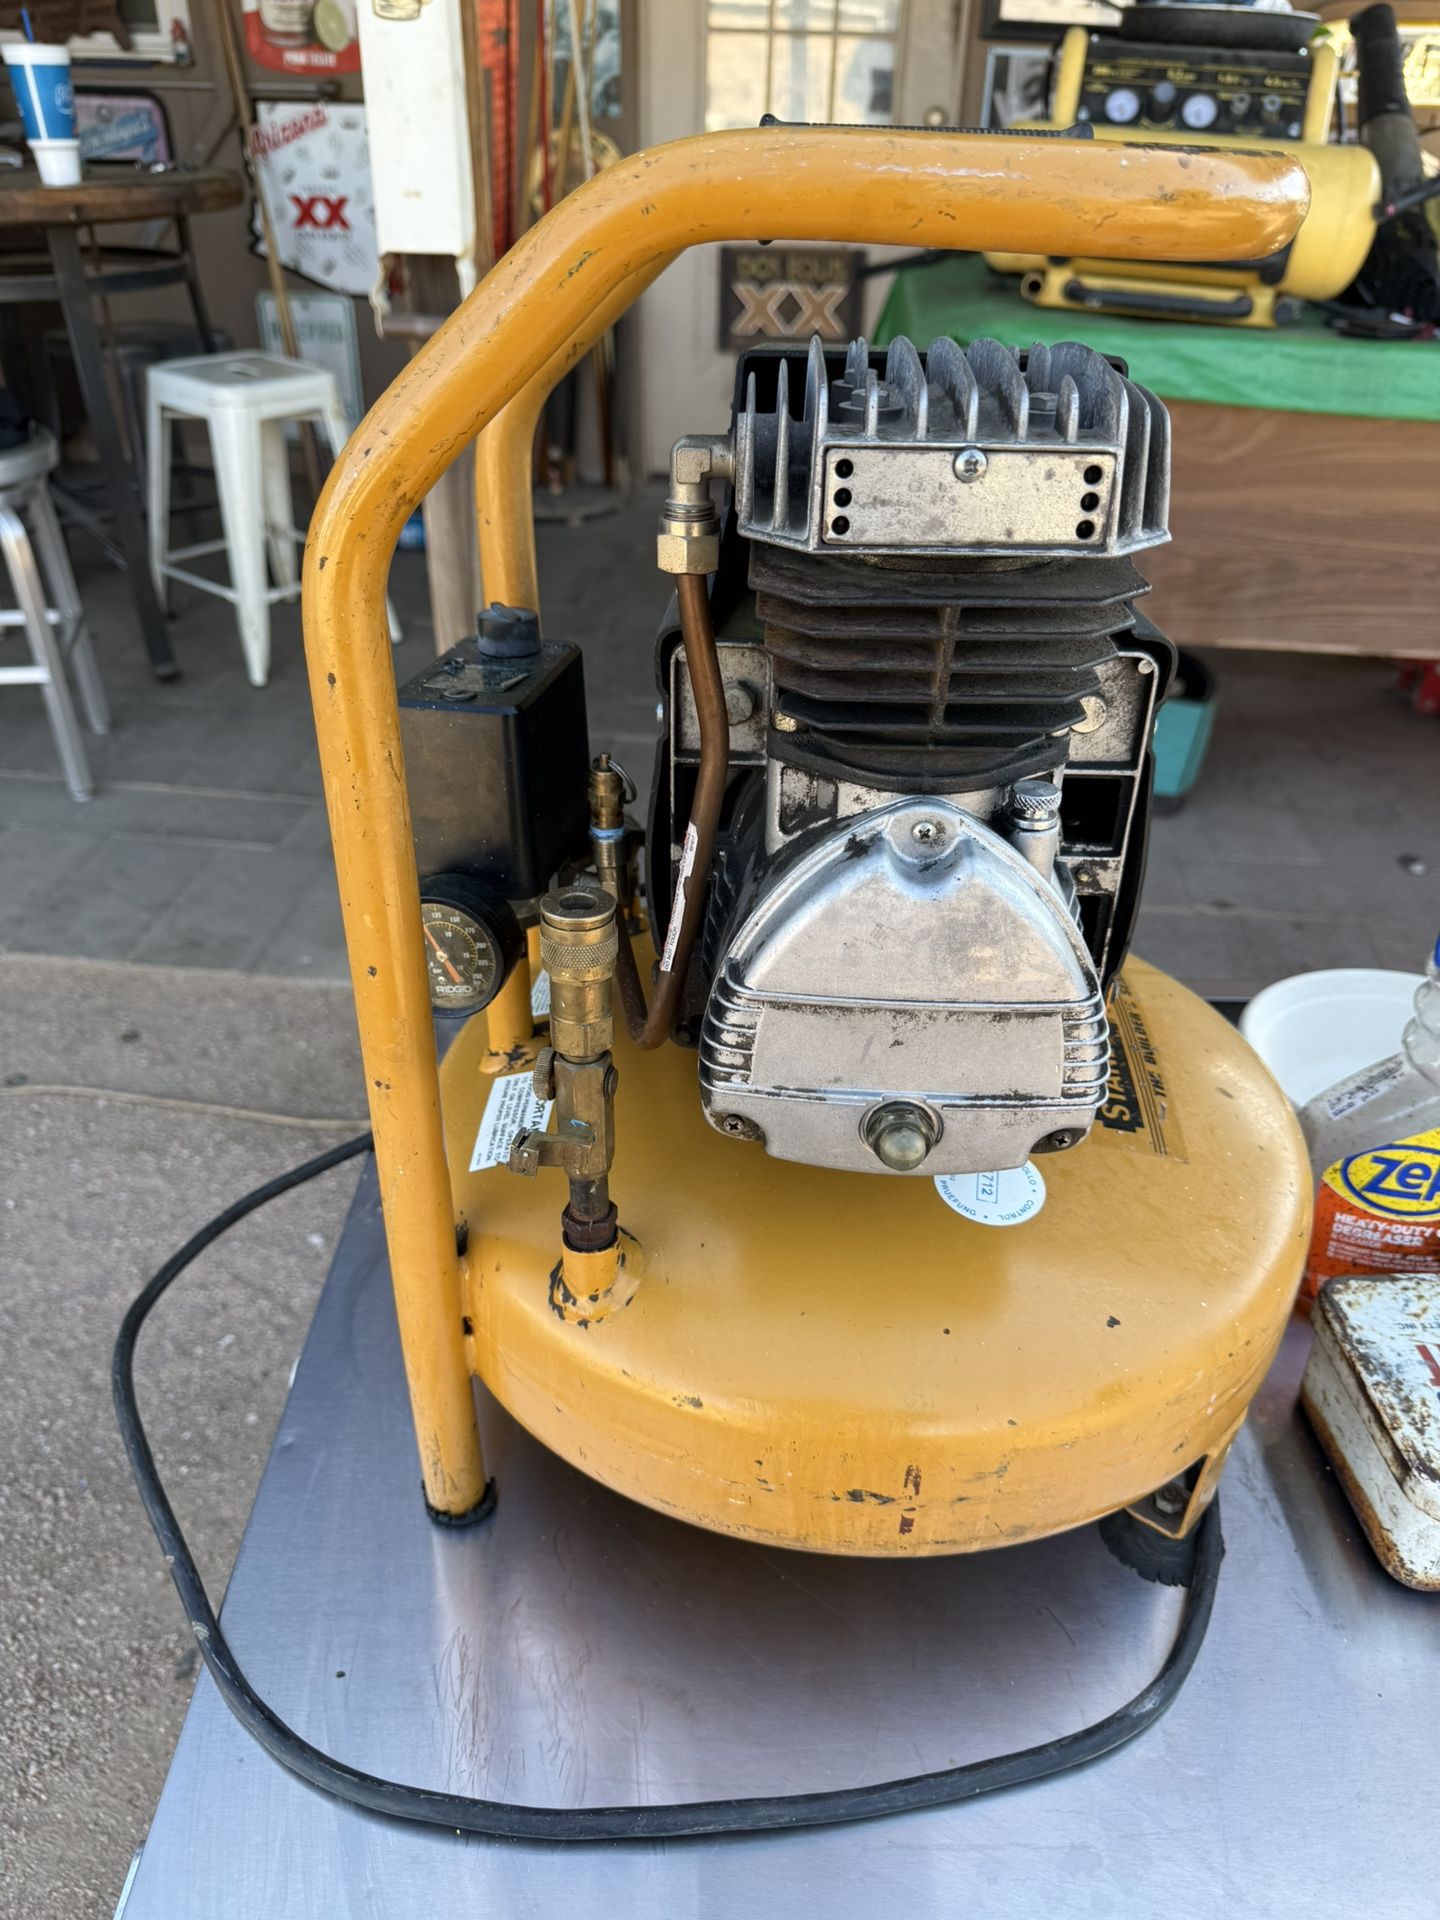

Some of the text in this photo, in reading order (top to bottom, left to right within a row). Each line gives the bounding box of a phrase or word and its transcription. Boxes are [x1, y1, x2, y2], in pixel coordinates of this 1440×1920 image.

[290, 195, 351, 229] XX
[731, 284, 849, 337] XX
[435, 985, 473, 993] RIDGID
[1148, 1070, 1167, 1097] THE
[940, 1179, 977, 1217] PRUEFUNG
[981, 1173, 994, 1197] 712
[998, 1199, 1034, 1221] CONTROL
[1331, 1222, 1425, 1247] DEGREASER
[1334, 1211, 1435, 1237] HEAVY-DUTY
